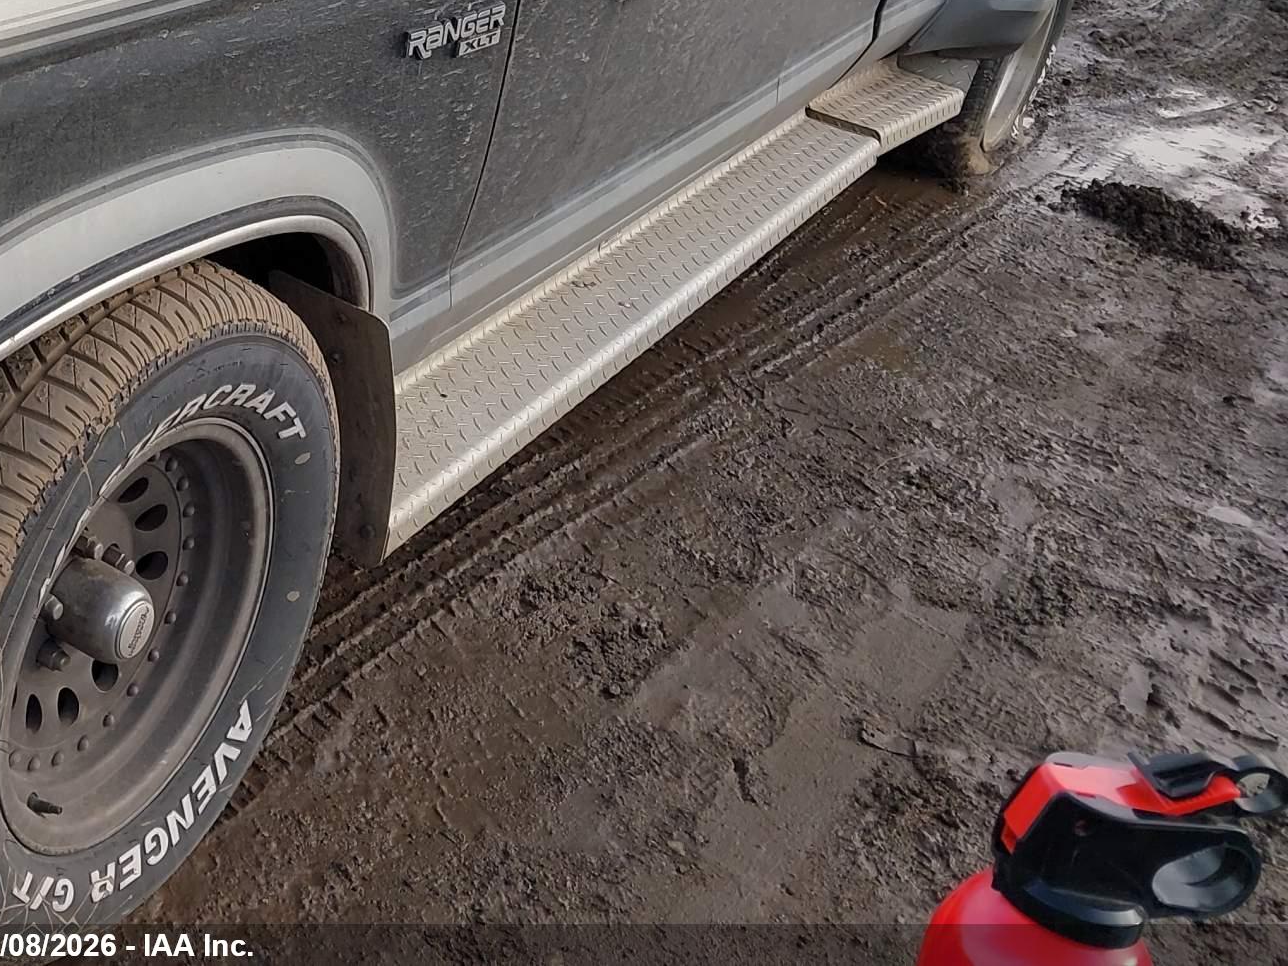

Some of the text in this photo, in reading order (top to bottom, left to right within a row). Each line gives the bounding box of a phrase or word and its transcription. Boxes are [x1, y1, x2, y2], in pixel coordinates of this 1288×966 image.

[408, 2, 507, 60] RANGER
[464, 33, 497, 52] XLT
[12, 699, 253, 912] AVENGER G/T
